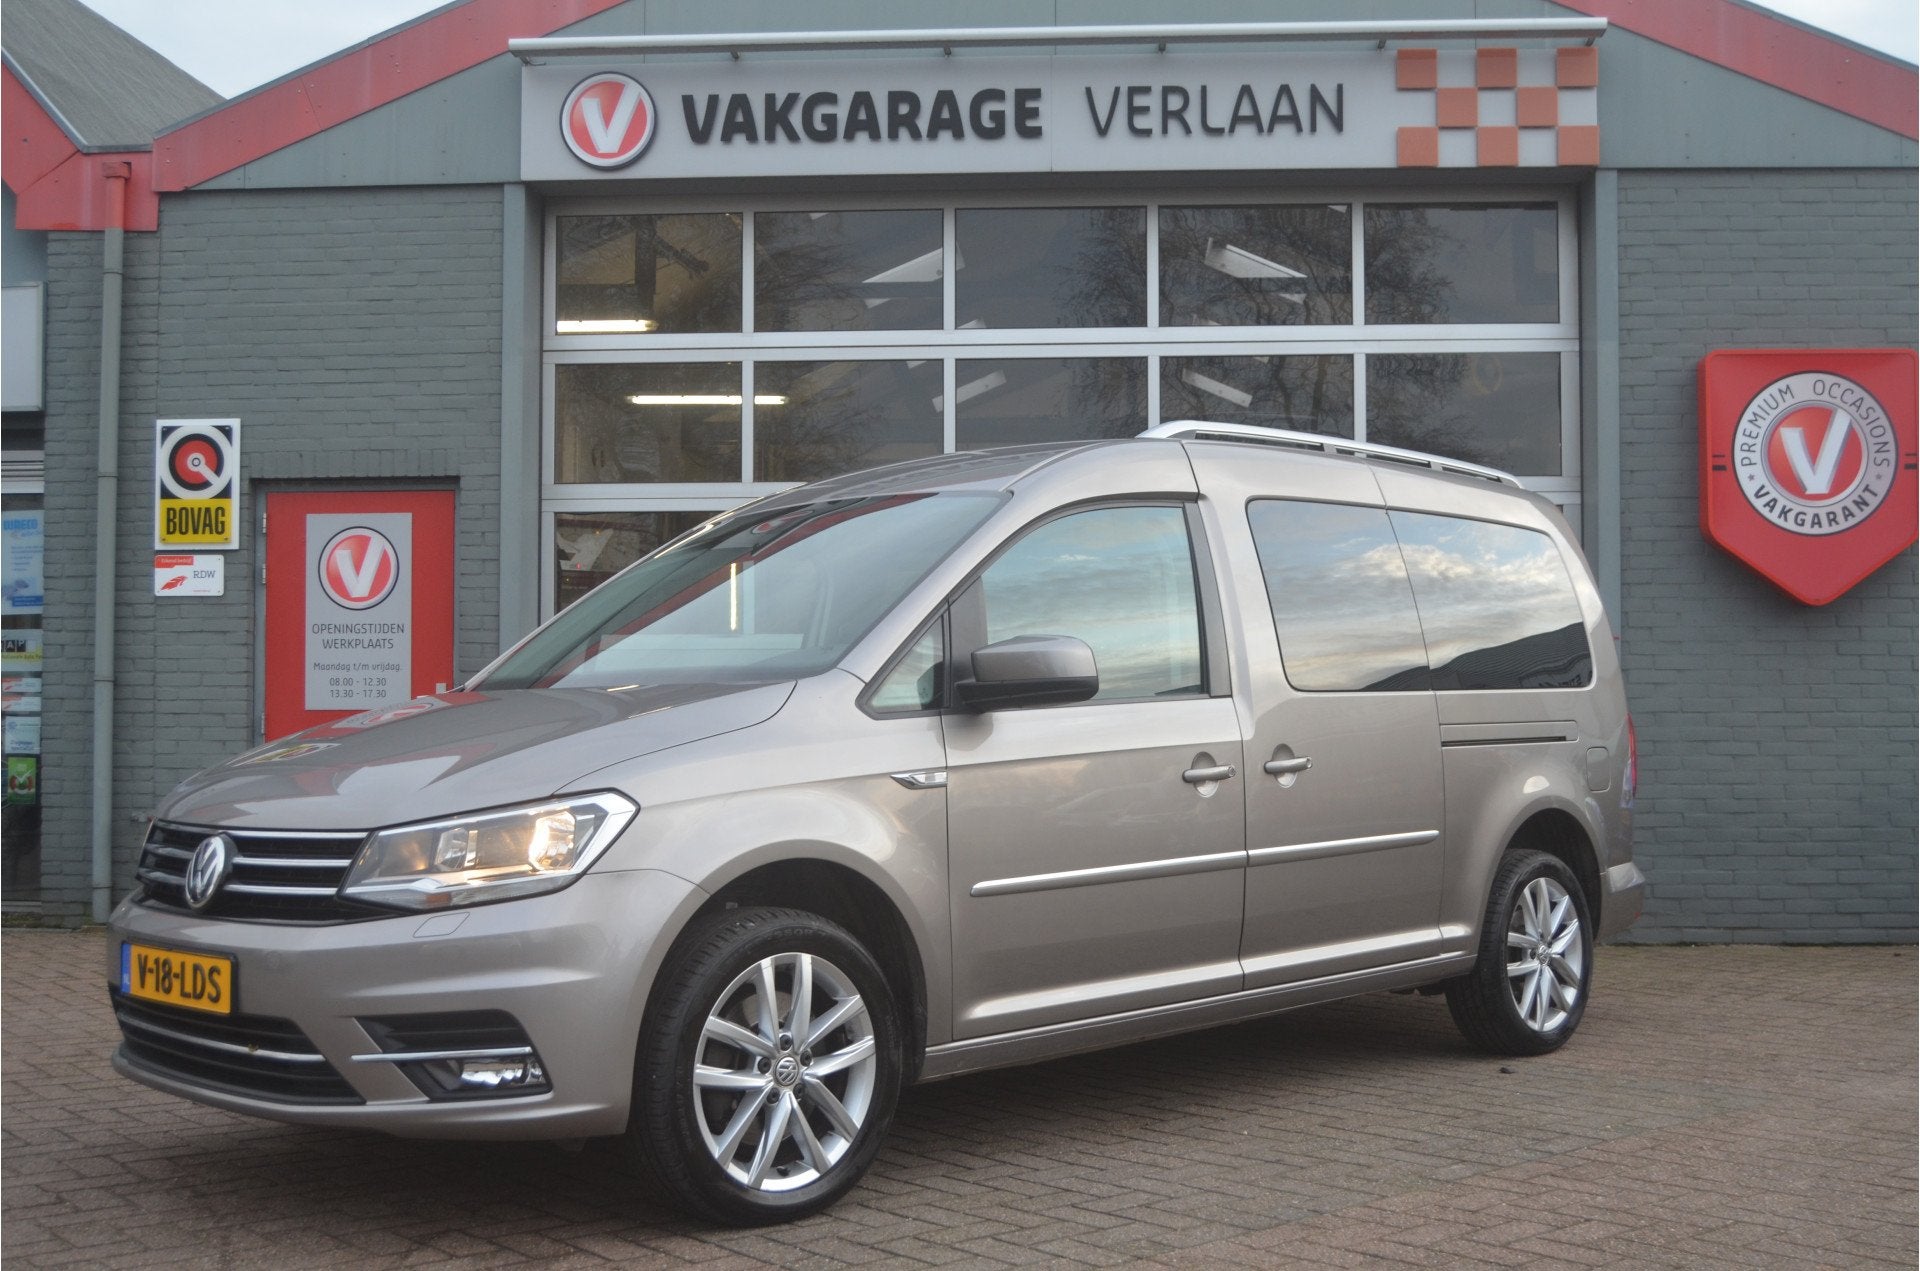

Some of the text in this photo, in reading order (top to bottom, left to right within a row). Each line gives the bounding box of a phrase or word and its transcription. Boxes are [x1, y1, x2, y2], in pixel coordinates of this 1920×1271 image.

[681, 88, 1043, 144] VAKGARAGE
[1085, 83, 1344, 138] VERLAAN
[1741, 379, 1890, 468] PREMIUM OCCASIONS
[1753, 483, 1879, 529] VAKGARANT
[166, 506, 226, 536] BOVAG
[193, 570, 216, 578] RDW
[312, 623, 405, 634] OPENINGSTIJDEN
[322, 638, 394, 649] WERKPLAATS
[313, 662, 351, 672] Maandag
[353, 662, 370, 671] t/m
[329, 678, 354, 686] 08.00
[363, 678, 387, 686] 12.30
[330, 690, 354, 698] 13.30
[363, 690, 387, 698] 17.30
[137, 953, 222, 1004] V-18-LDS
